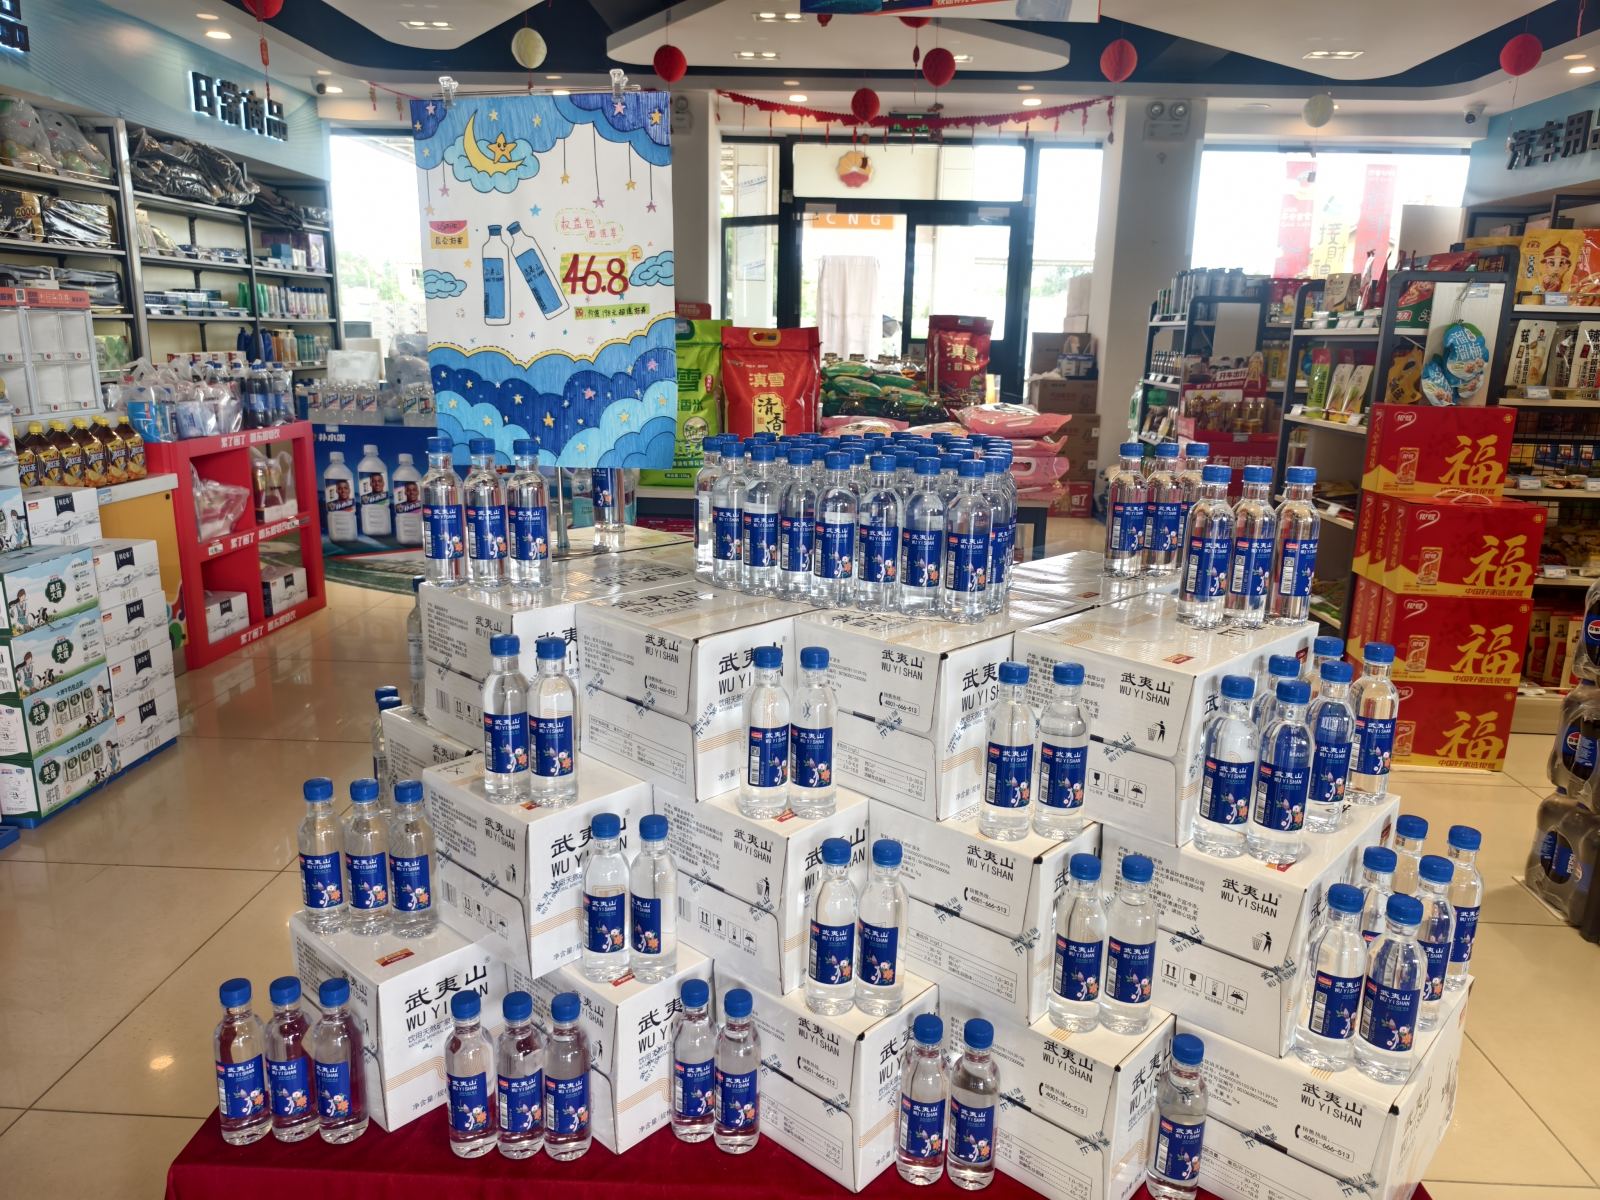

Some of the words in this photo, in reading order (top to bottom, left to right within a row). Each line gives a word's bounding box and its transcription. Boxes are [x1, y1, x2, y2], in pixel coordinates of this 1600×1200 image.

[631, 248, 642, 260] 元
[562, 253, 630, 296] 46.8
[1439, 434, 1504, 486] 福
[1463, 534, 1533, 587] 福
[476, 616, 501, 632] 武夷山
[645, 633, 679, 651] 武夷山
[1451, 624, 1519, 674] 福
[882, 649, 923, 668] 武夷山
[1121, 672, 1170, 694] 武夷山
[1436, 711, 1504, 760] 福
[485, 817, 515, 840] 武夷山
[734, 829, 772, 852] 武夷山
[968, 844, 1014, 870] 武夷山
[1222, 878, 1279, 906] 武夷山
[799, 1016, 840, 1046] 武夷山
[1043, 1040, 1093, 1072] 武夷山
[1302, 1082, 1362, 1116] 武夷山
[1303, 1134, 1350, 1160] 4001-666-513
